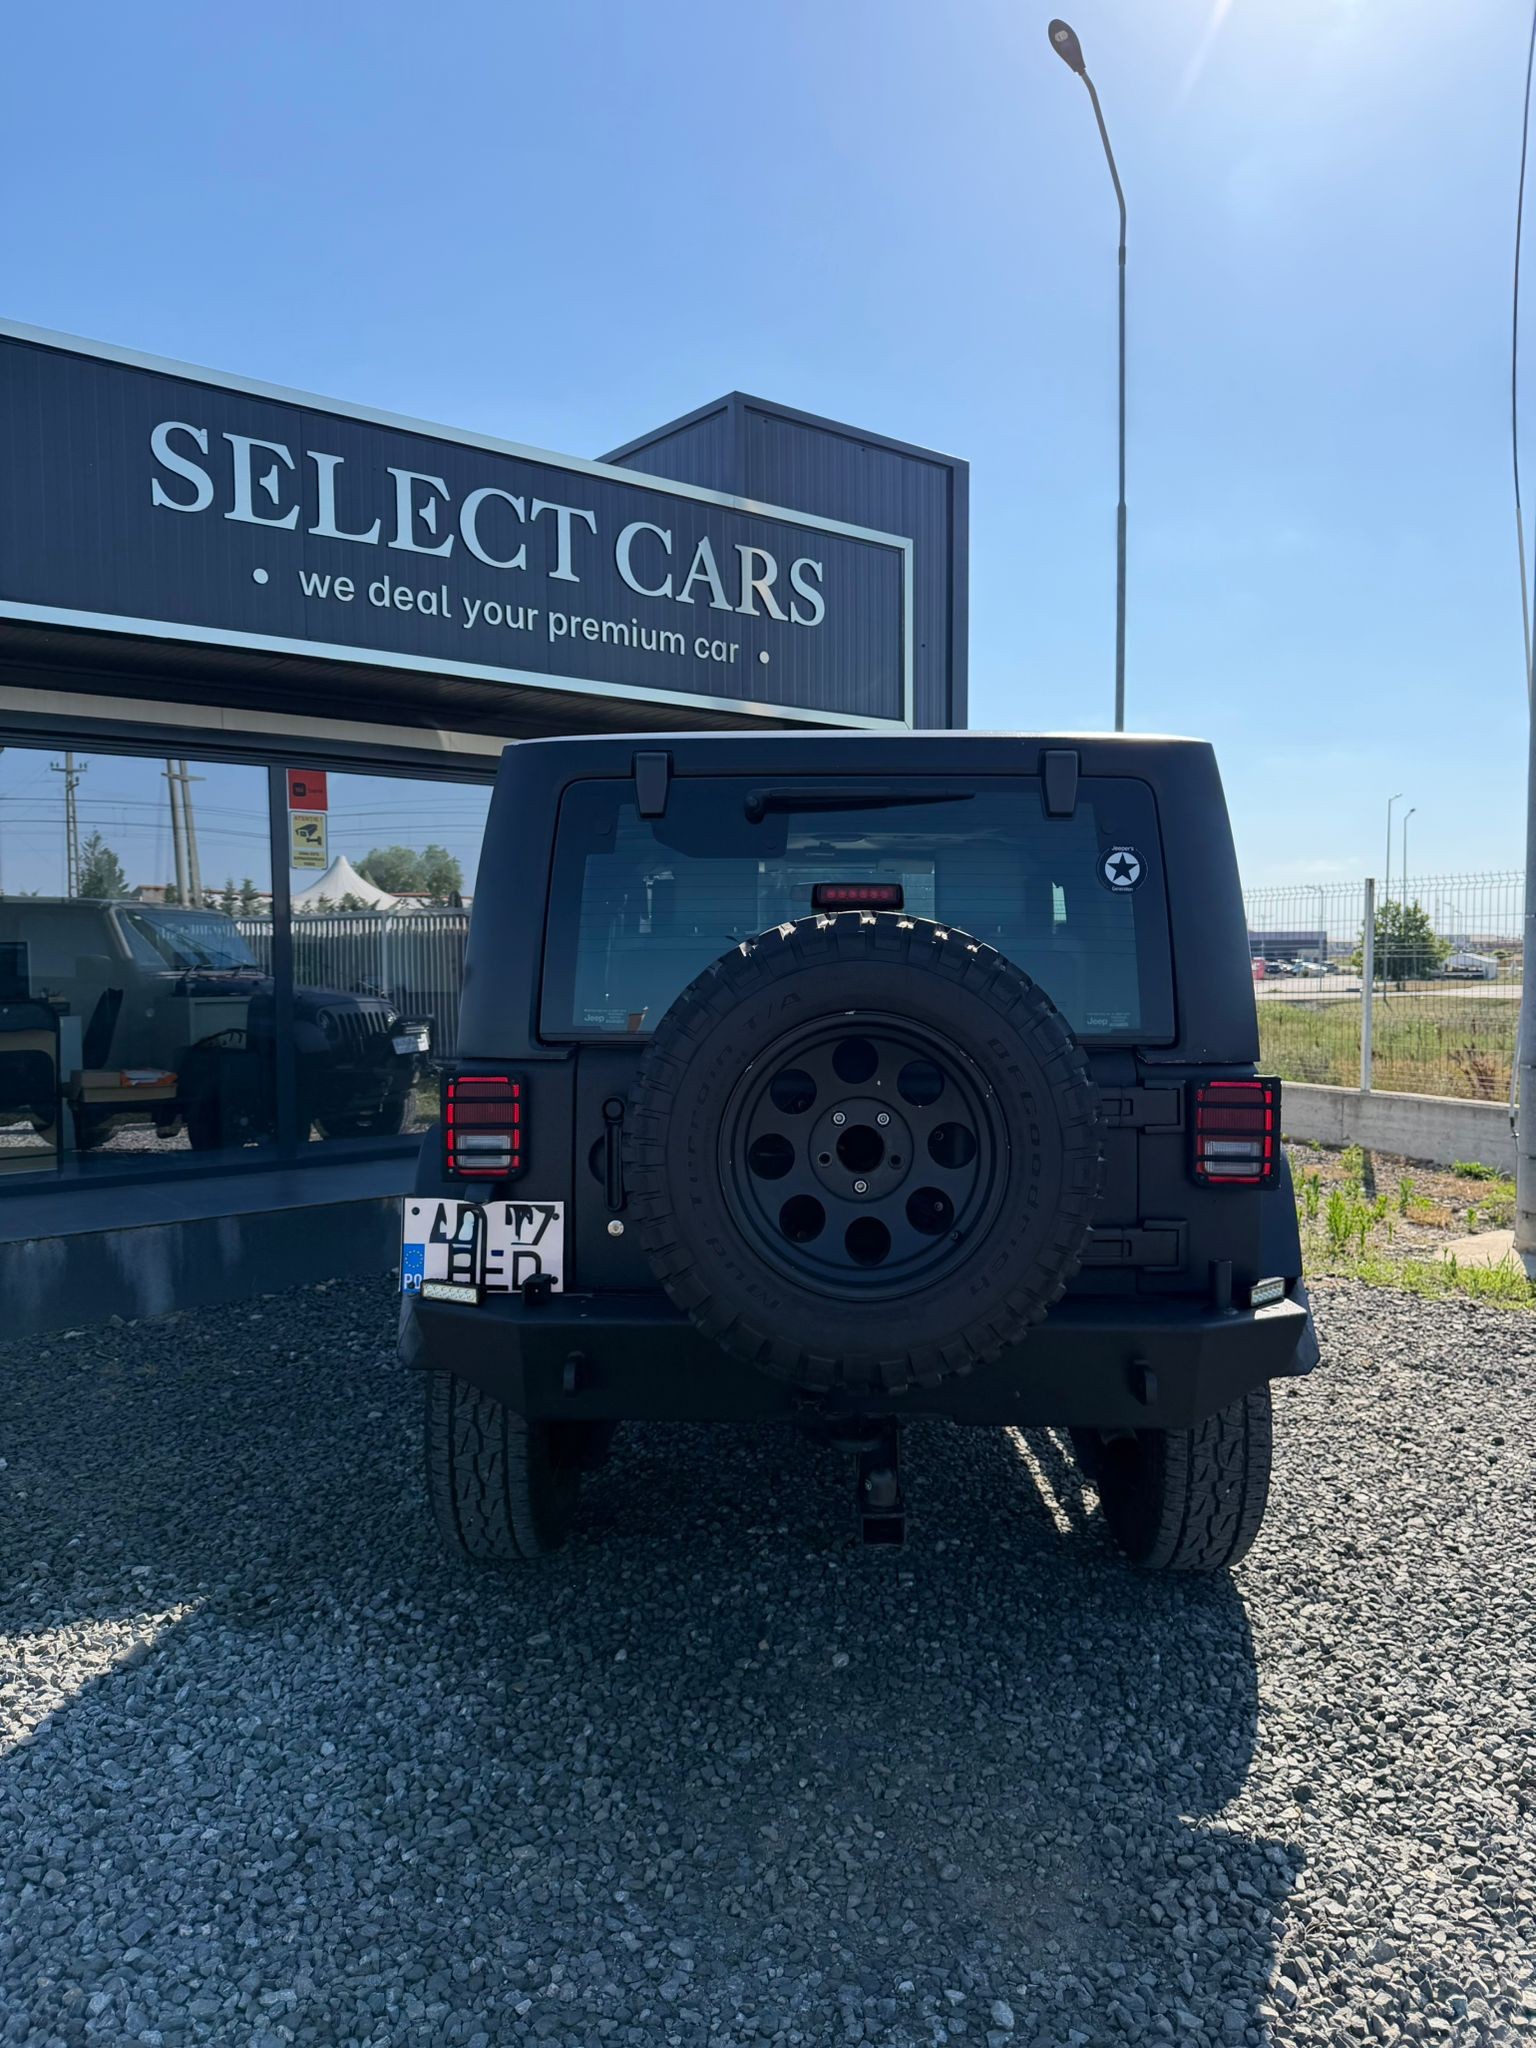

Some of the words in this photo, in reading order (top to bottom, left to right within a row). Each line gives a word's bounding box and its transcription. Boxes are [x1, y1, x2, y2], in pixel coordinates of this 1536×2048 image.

[150, 421, 598, 583] SELECT
[615, 521, 827, 627] CARS
[298, 569, 355, 603] we
[367, 574, 452, 619] deal
[462, 595, 540, 631] your
[548, 610, 687, 656] premium
[693, 636, 741, 665] car
[584, 1013, 605, 1024] Jeep
[1086, 1015, 1108, 1026] Jeep
[968, 1038, 1043, 1296] BFGoodrich
